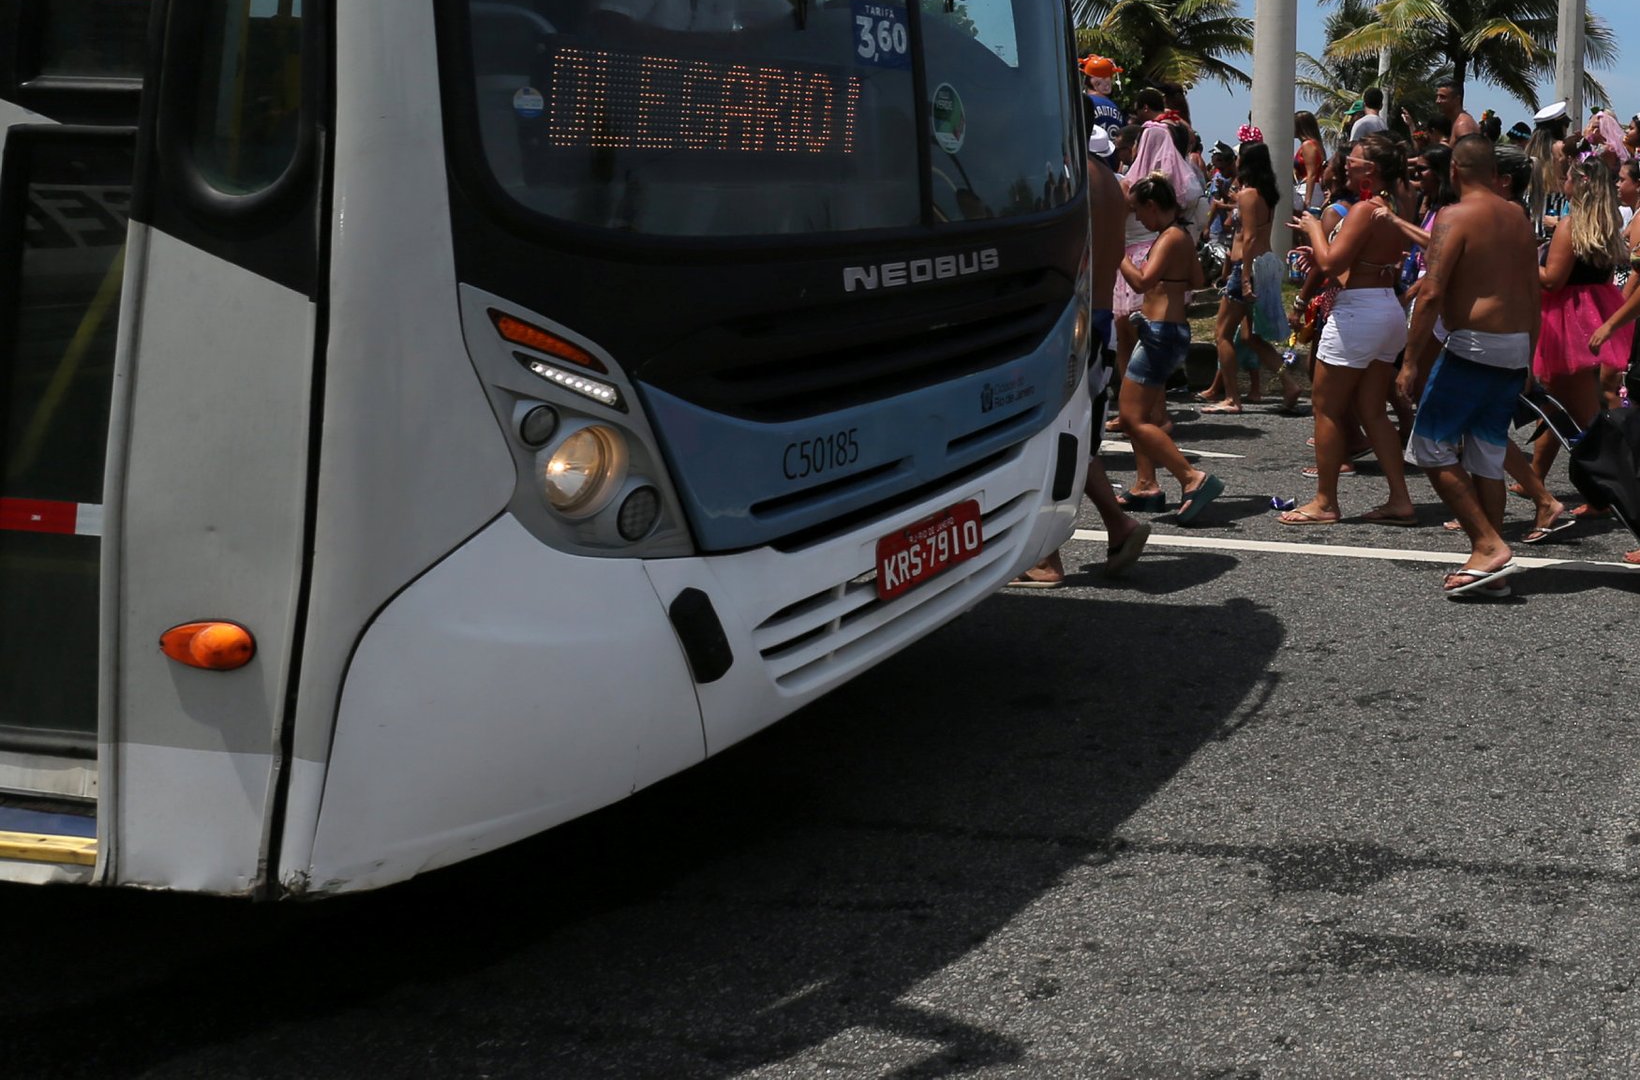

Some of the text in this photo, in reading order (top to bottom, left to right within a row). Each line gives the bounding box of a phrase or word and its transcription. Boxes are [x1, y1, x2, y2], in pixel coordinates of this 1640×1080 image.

[865, 5, 895, 19] TARIFA
[856, 15, 908, 62] 3,60
[843, 247, 1000, 293] NEOBUS
[782, 428, 859, 480] C50185
